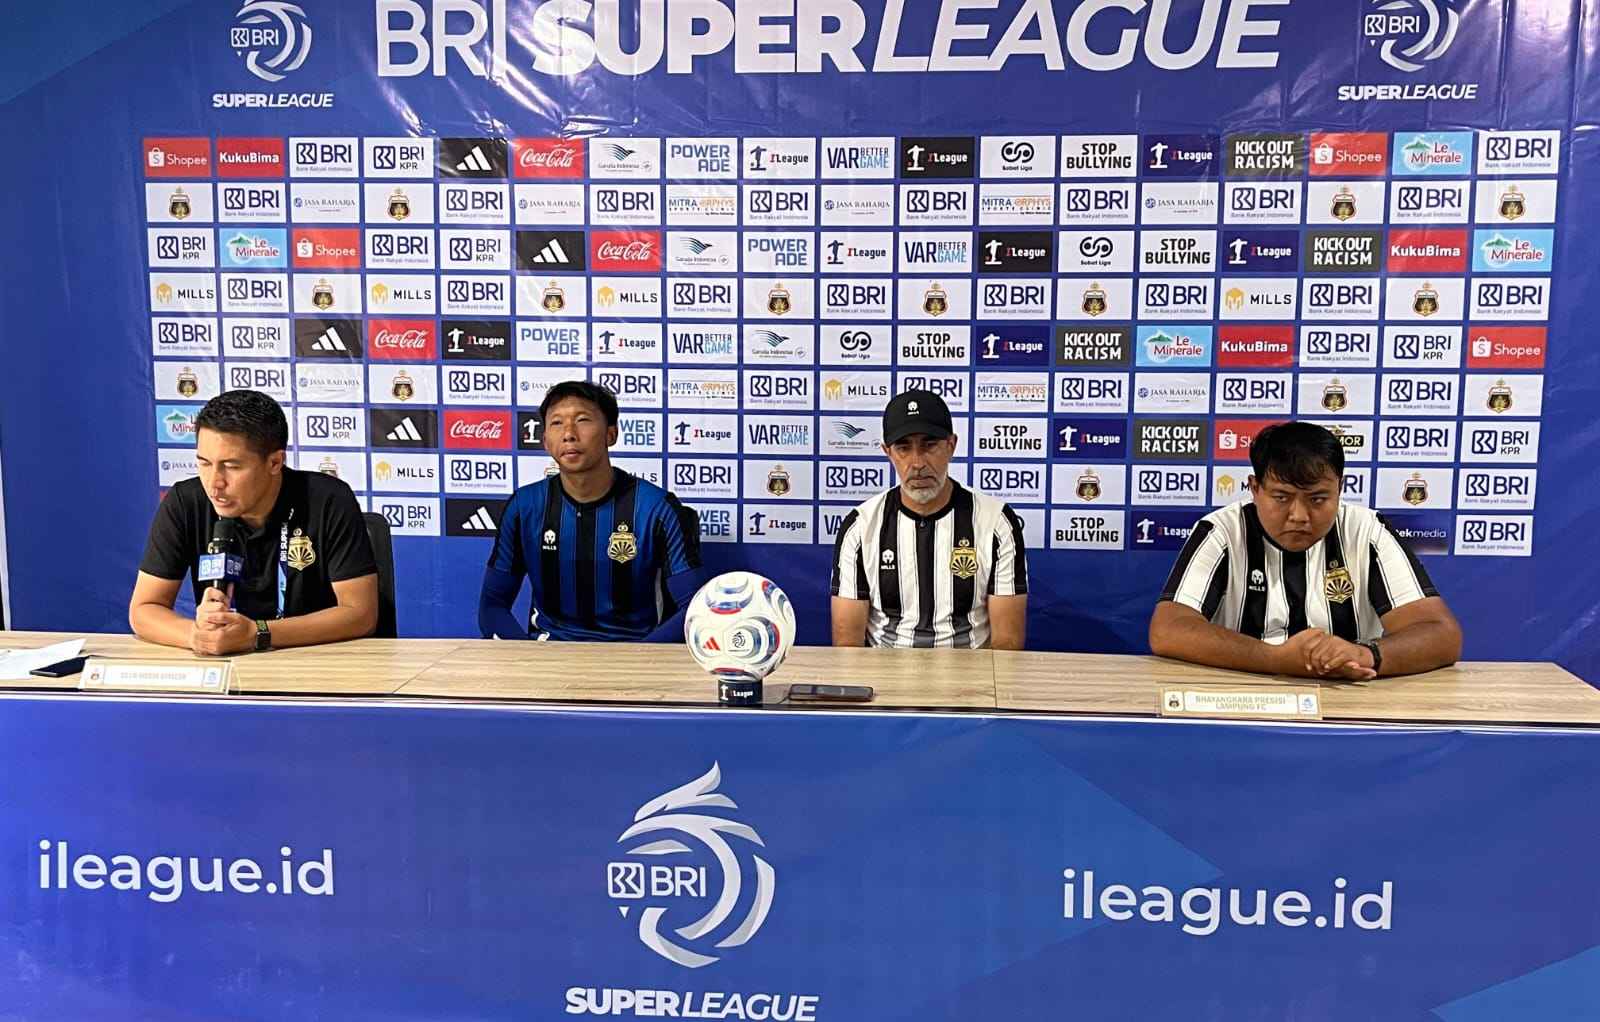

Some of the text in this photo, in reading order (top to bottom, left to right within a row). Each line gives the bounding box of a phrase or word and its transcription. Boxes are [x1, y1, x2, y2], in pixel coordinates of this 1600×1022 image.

[1390, 17, 1420, 33] BRI
[252, 29, 278, 45] BRI
[376, 0, 506, 77] BRI
[321, 145, 352, 162] BRI
[671, 145, 730, 157] POWER
[860, 148, 888, 157] BETTER
[1082, 144, 1116, 155] STOP
[1236, 141, 1294, 154] KICK OUT
[1435, 143, 1448, 152] Le
[1516, 140, 1551, 158] BRI
[220, 152, 279, 162] KukuBima
[400, 147, 424, 161] BRI
[828, 148, 859, 168] VAR
[1336, 151, 1381, 163] Shopee
[1411, 152, 1461, 163] Minerale
[167, 154, 207, 167] Shopee
[698, 160, 730, 171] ADE
[860, 157, 888, 168] GAME
[1067, 157, 1131, 169] BULLYING
[1235, 155, 1294, 168] RACISM
[472, 192, 503, 209] BRI
[776, 193, 807, 210] BRI
[982, 198, 1012, 206] MITRA
[1095, 192, 1128, 209] BRI
[1258, 190, 1293, 208] BRI
[183, 237, 205, 250] BRI
[254, 238, 267, 248] Le
[397, 237, 427, 254] BRI
[476, 239, 500, 253] BRI
[749, 239, 807, 251] POWER
[938, 242, 967, 251] BETTER
[1162, 239, 1195, 250] STOP
[1314, 238, 1371, 250] KICK OUT
[1516, 240, 1530, 250] Le
[236, 248, 279, 257] Minerale
[316, 245, 355, 256] Shopee
[905, 242, 937, 263] VAR
[938, 251, 967, 262] GAME
[1391, 246, 1460, 257] KukuBima
[1491, 250, 1543, 260] Minerale
[775, 254, 807, 265] ADE
[1145, 252, 1210, 264] BULLYING
[1314, 252, 1372, 264] RACISM
[178, 289, 214, 299] MILLS
[252, 281, 282, 298] BRI
[394, 290, 431, 300] MILLS
[473, 284, 503, 301] BRI
[853, 287, 885, 304] BRI
[1173, 287, 1206, 304] BRI
[1338, 286, 1371, 304] BRI
[1507, 286, 1541, 304] BRI
[620, 293, 657, 302] MILLS
[1250, 294, 1292, 304] MILLS
[258, 328, 280, 340] BRI
[522, 329, 579, 341] POWER
[705, 334, 732, 342] BETTER
[917, 333, 950, 344] STOP
[1065, 333, 1122, 345] KICK OUT
[673, 333, 705, 354] VAR
[1176, 336, 1189, 346] Le
[1222, 340, 1288, 353] KukuBima
[1424, 336, 1451, 349] BRI
[548, 343, 579, 354] ADE
[705, 342, 732, 353] GAME
[903, 346, 964, 357] BULLYING
[1065, 347, 1121, 359] RACISM
[1154, 346, 1203, 355] Minerale
[1494, 344, 1540, 357] Shopee
[255, 370, 284, 386] BRI
[474, 374, 504, 391] BRI
[776, 378, 807, 395] BRI
[848, 386, 886, 395] MILLS
[931, 380, 962, 397] BRI
[1088, 381, 1121, 398] BRI
[1251, 380, 1284, 398] BRI
[1417, 382, 1451, 400] BRI
[333, 417, 355, 429] BRI
[619, 420, 655, 432] WER
[781, 425, 808, 433] BETTER
[333, 431, 349, 439] KPR
[749, 425, 780, 445] VAR
[994, 426, 1027, 436] STOP
[1142, 427, 1199, 439] KICK OUT
[624, 434, 655, 445] ADE
[781, 434, 808, 445] GAME
[979, 438, 1041, 450] BULLYING
[1414, 429, 1448, 447] BRI
[1502, 431, 1528, 445] BRI
[1142, 441, 1199, 453] RACISM
[1500, 447, 1520, 455] KPR
[397, 468, 433, 477] MILLS
[476, 462, 506, 479] BRI
[852, 470, 882, 486] BRI
[1166, 474, 1199, 490] BRI
[1344, 475, 1363, 493] RI
[1494, 477, 1528, 495] BRI
[408, 507, 431, 519] BRI
[699, 510, 730, 522] WER
[825, 515, 842, 533] VA
[1071, 518, 1104, 529] STOP
[700, 525, 730, 536] ADE
[1056, 530, 1118, 542] BULLYING
[1397, 529, 1446, 538] ekmedia
[1490, 523, 1524, 541] BRI
[39, 840, 334, 902] ileague.id
[651, 870, 706, 898] BRI
[1064, 869, 1392, 935] ileague.id
